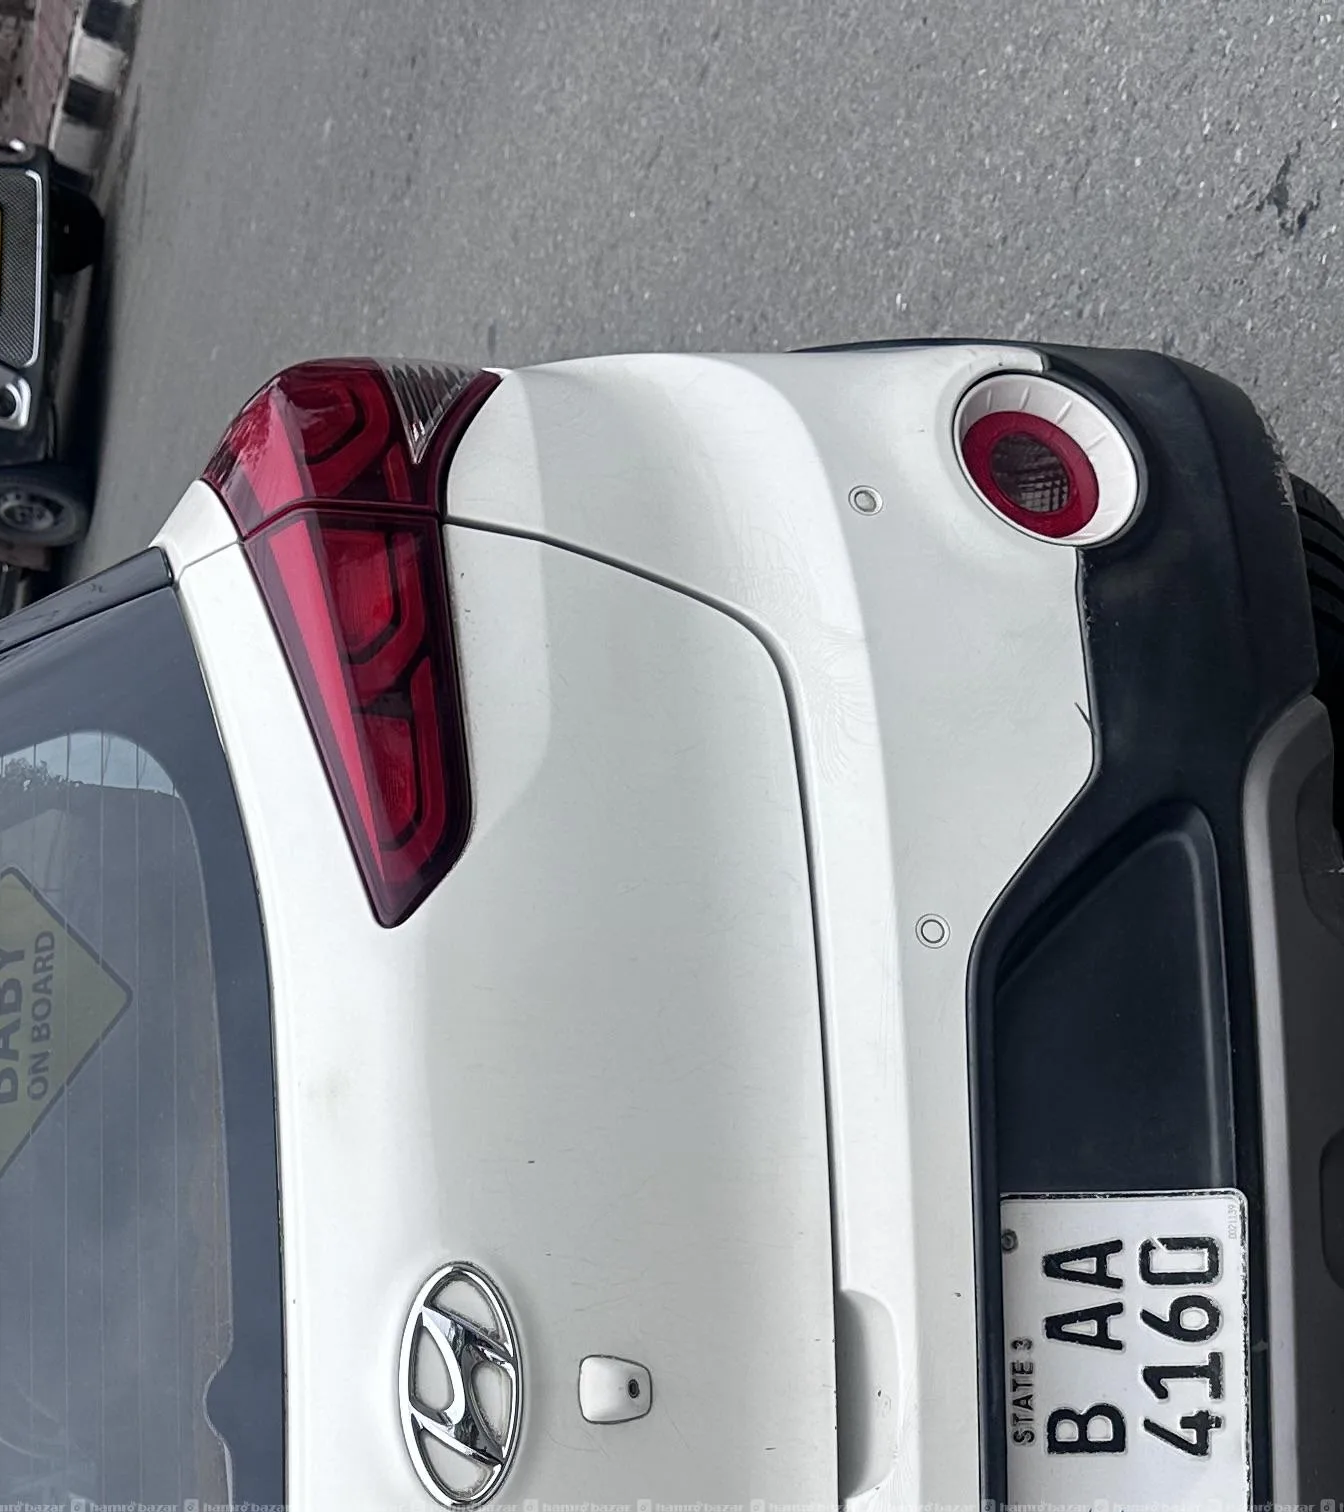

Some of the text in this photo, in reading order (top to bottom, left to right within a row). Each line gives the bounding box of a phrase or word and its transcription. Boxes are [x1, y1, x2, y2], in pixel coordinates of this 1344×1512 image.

[26, 930, 55, 1101] ON BOARD
[1010, 1337, 1035, 1444] STATE 3
[1042, 1238, 1126, 1455] B AA
[1138, 1236, 1224, 1458] 4160
